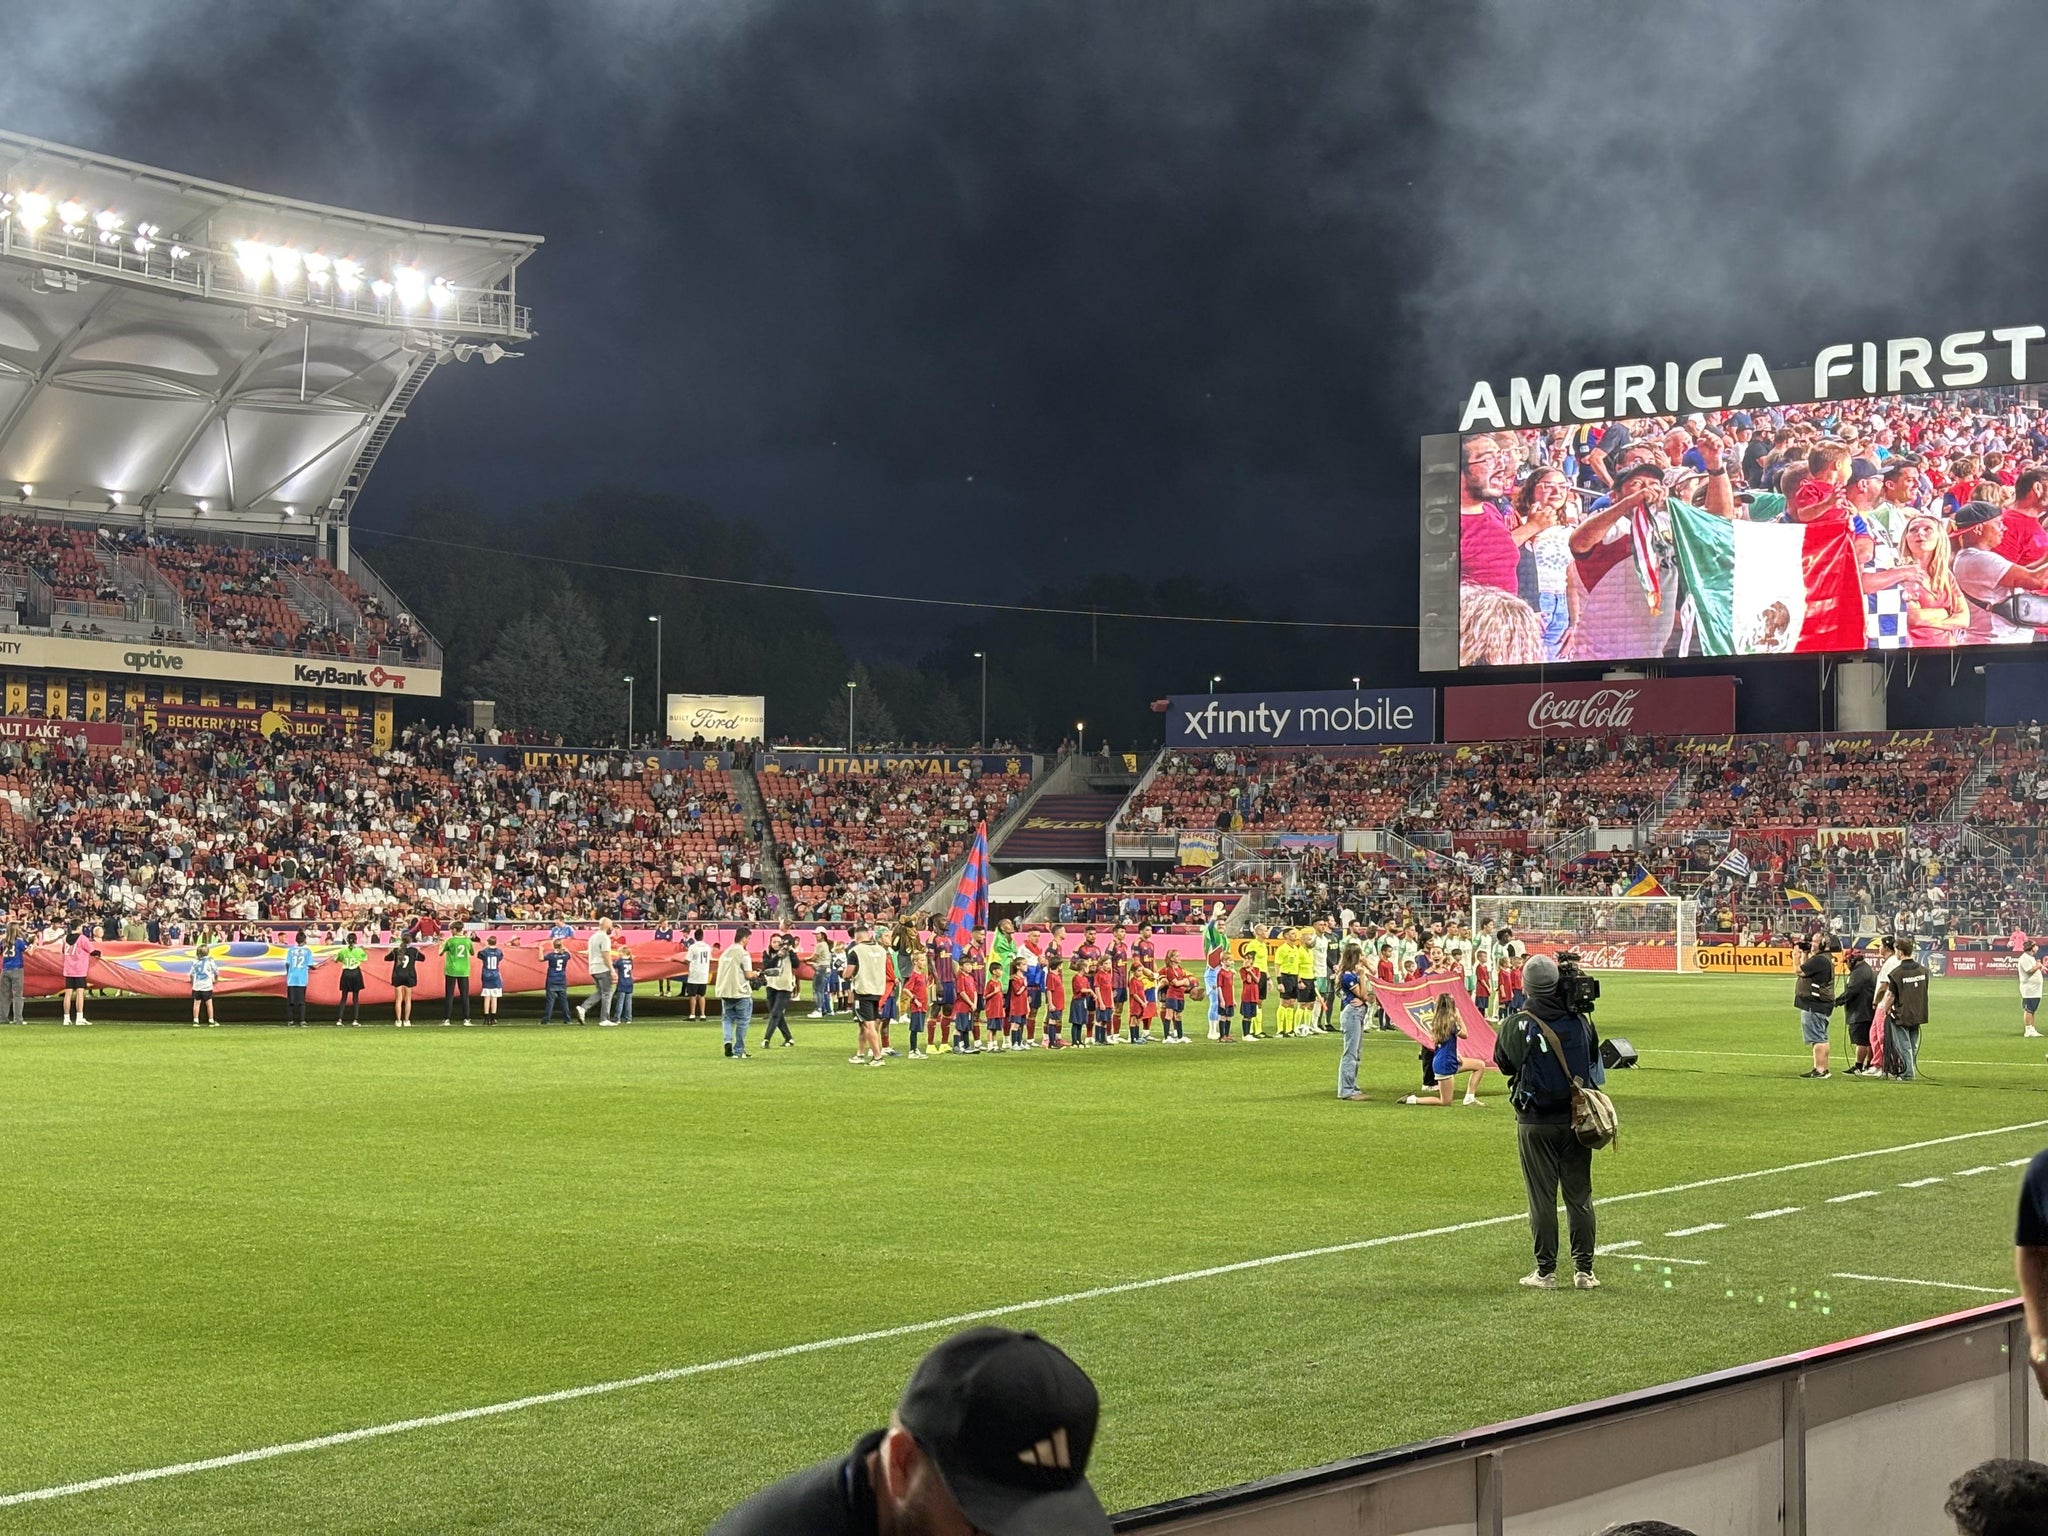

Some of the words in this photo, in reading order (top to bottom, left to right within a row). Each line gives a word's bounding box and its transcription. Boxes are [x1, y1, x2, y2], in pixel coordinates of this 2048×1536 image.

[1458, 353, 1780, 432] AMERICA
[1814, 325, 2047, 399] FIRST
[124, 649, 183, 671] aptive
[294, 664, 368, 687] KeyBank
[1527, 688, 1641, 730] Coca-Cola
[143, 711, 157, 734] 5
[690, 708, 740, 730] Ford
[1183, 701, 1291, 740] xfinity
[1299, 697, 1414, 732] mobile
[26, 723, 61, 738] LAKE
[296, 724, 334, 736] BLOC
[818, 759, 879, 774] UTAH
[457, 945, 465, 957] 2
[292, 956, 305, 968] 12
[487, 956, 497, 969] 10
[556, 959, 563, 971] 5
